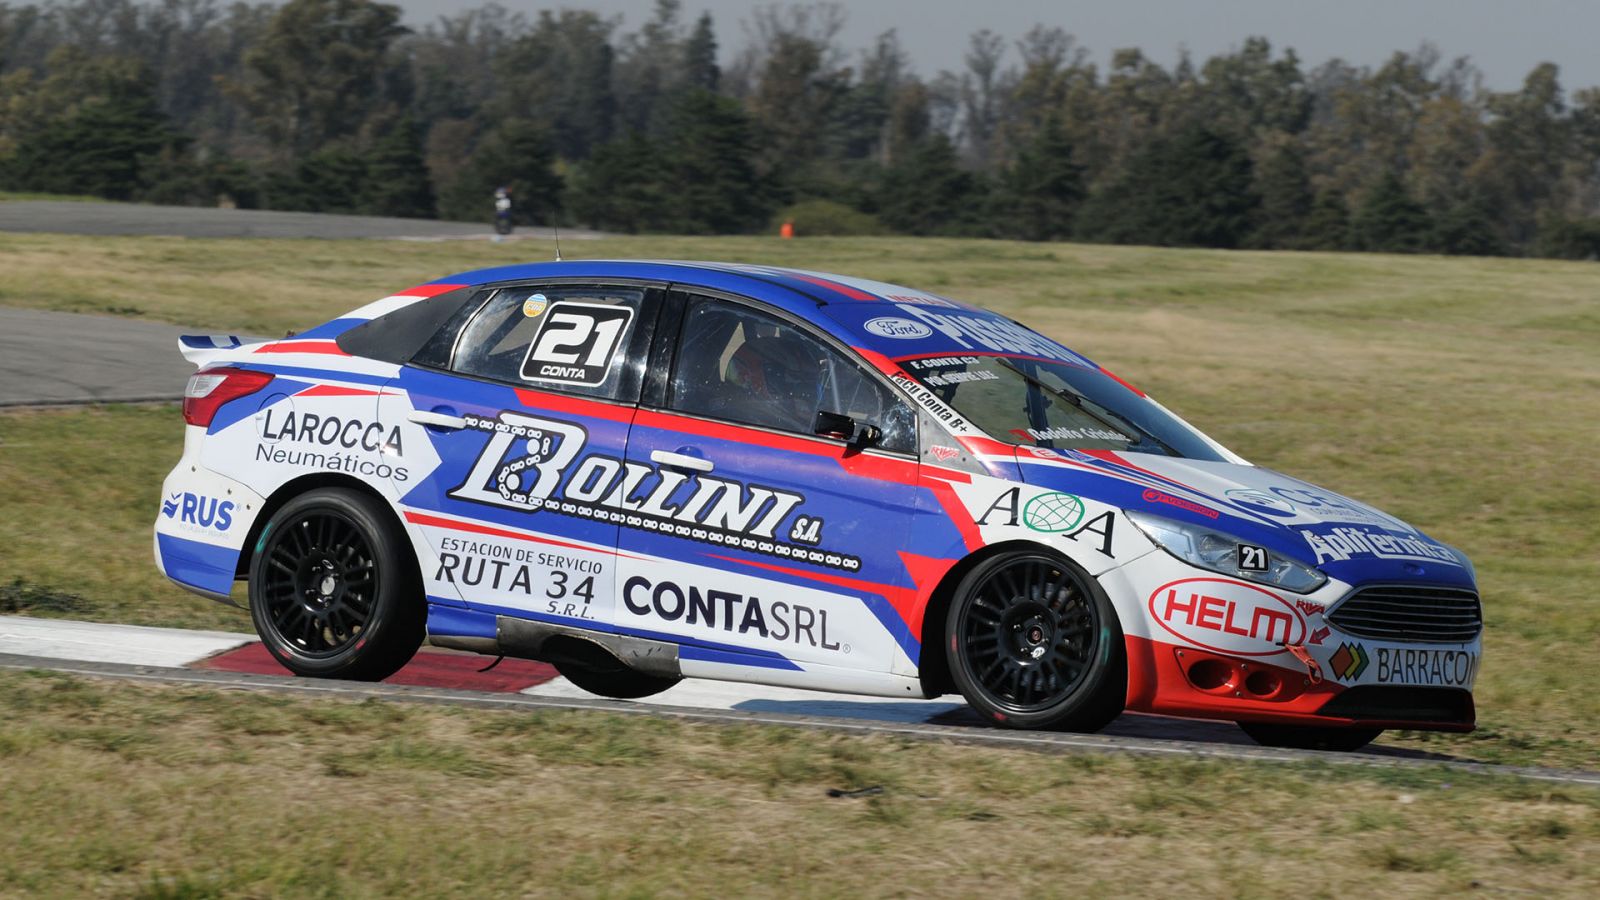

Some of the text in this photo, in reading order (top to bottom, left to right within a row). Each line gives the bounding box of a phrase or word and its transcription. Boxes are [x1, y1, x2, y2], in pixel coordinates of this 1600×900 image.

[531, 312, 625, 368] 21
[539, 365, 586, 380] CONTA
[922, 356, 962, 369] CONTA
[890, 370, 968, 433] Facu Conta B+
[262, 408, 404, 458] LAROCCA
[1027, 426, 1084, 441] Rodolfo
[255, 443, 409, 482] Neumáticos
[448, 411, 821, 544] BOLLINI S.A.
[181, 492, 235, 531] RUS
[440, 536, 603, 575] ESTACION DE SERVICIO
[1241, 545, 1267, 569] 21
[434, 553, 596, 604] RUTA 34
[545, 600, 596, 620] S.R.L.
[1163, 588, 1294, 643] HELM
